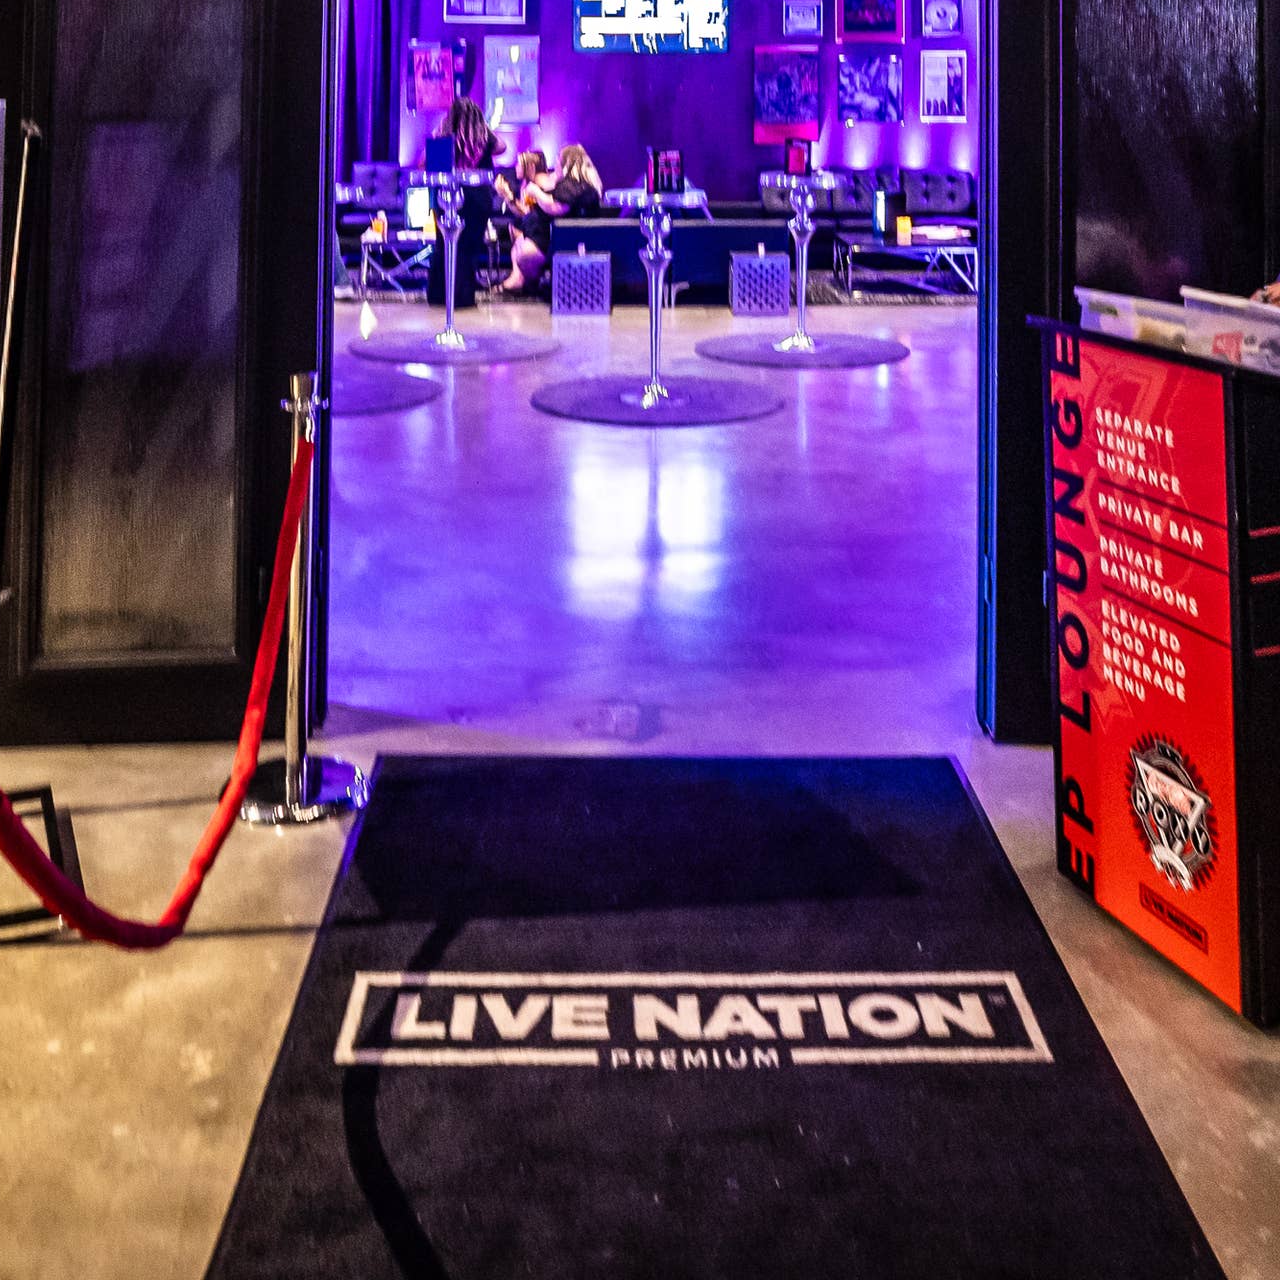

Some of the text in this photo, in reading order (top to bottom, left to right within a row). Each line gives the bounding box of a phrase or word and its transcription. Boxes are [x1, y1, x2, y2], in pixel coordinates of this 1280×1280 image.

[1095, 406, 1175, 448] SEPARATE
[1096, 427, 1146, 462] VENUE
[1097, 449, 1181, 496] ENTRANCE
[1098, 492, 1204, 551] PRIVATE BAR
[1099, 534, 1164, 580] PRIVATE
[1100, 556, 1199, 618] BATHROOMS
[1050, 329, 1095, 899] EP LOUNGE
[1101, 598, 1181, 654] ELEVATED
[1102, 620, 1186, 679] FOOD AND
[1102, 641, 1186, 703] BEVERAGE
[1103, 663, 1146, 703] MENU
[391, 991, 996, 1041] LIVE NATION
[611, 1047, 780, 1071] PREMIUM
